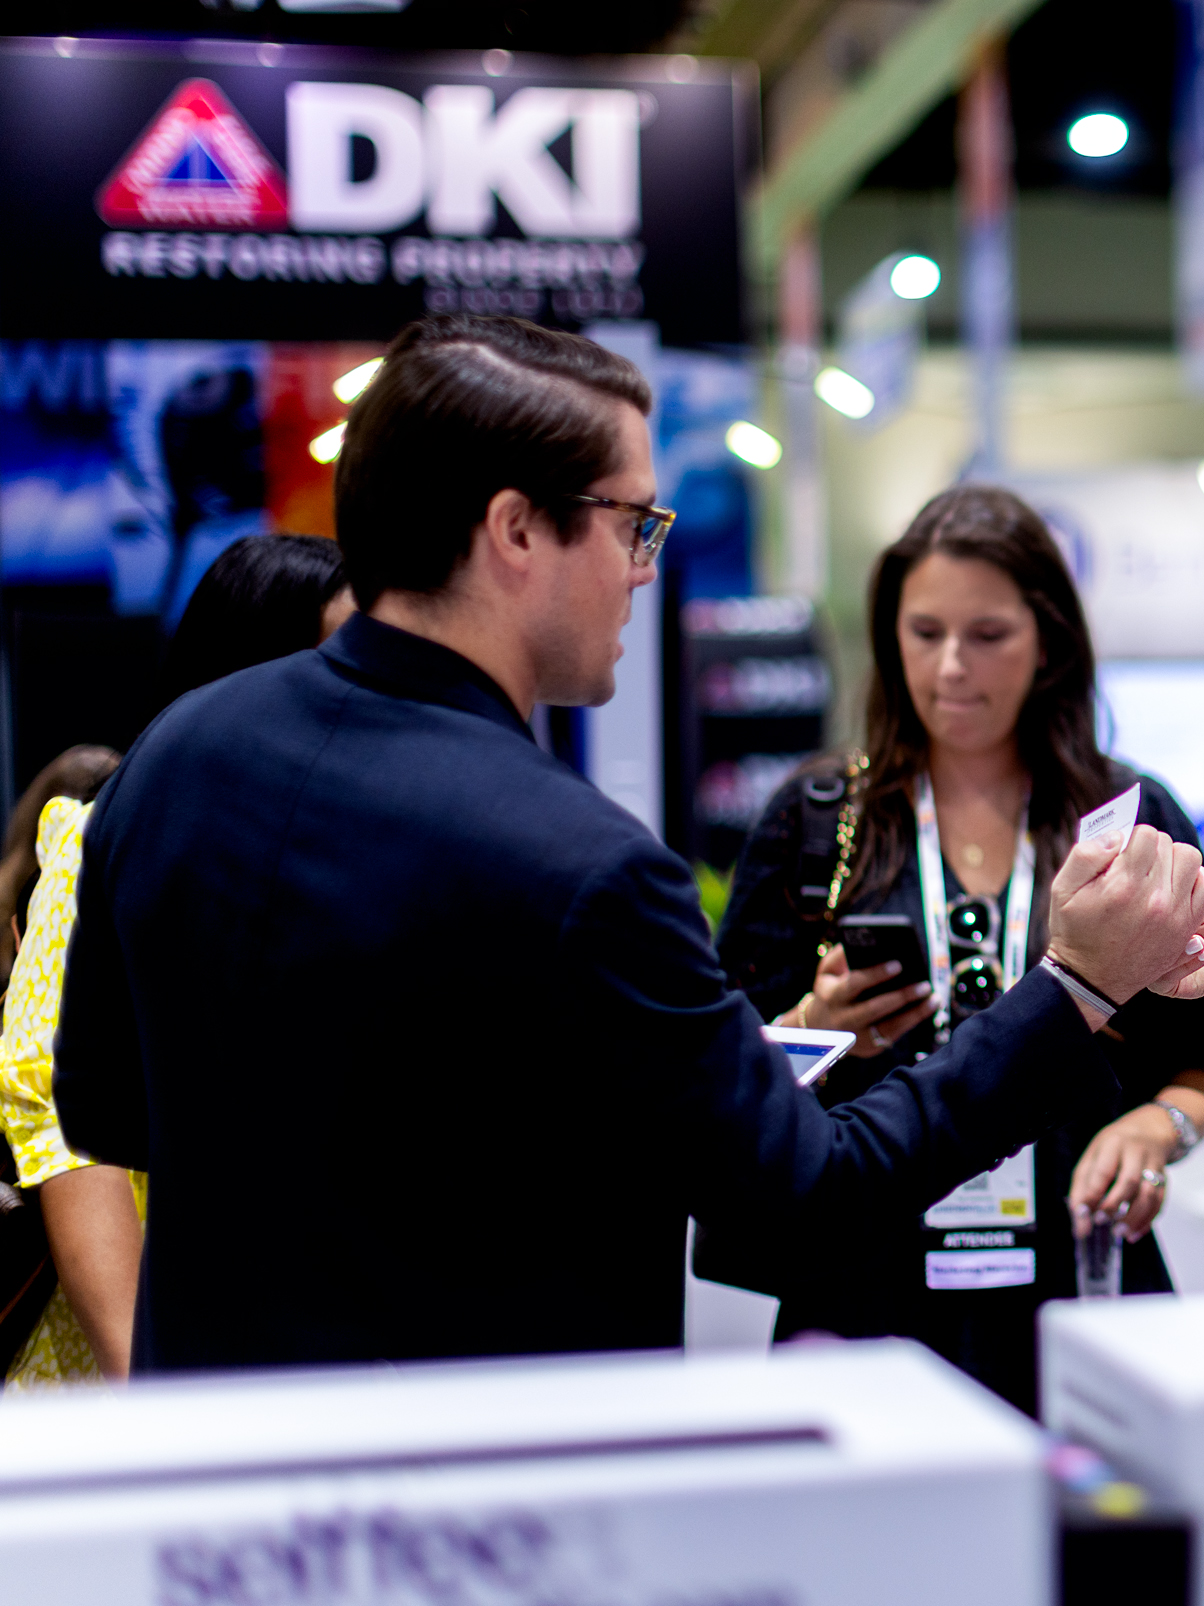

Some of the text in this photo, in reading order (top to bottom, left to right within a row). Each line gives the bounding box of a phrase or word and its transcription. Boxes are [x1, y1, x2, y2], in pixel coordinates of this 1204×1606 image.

[286, 80, 641, 238] DKI
[101, 231, 645, 292] RESTORING PROPERTY
[942, 1231, 1016, 1248] ATTENDEE
